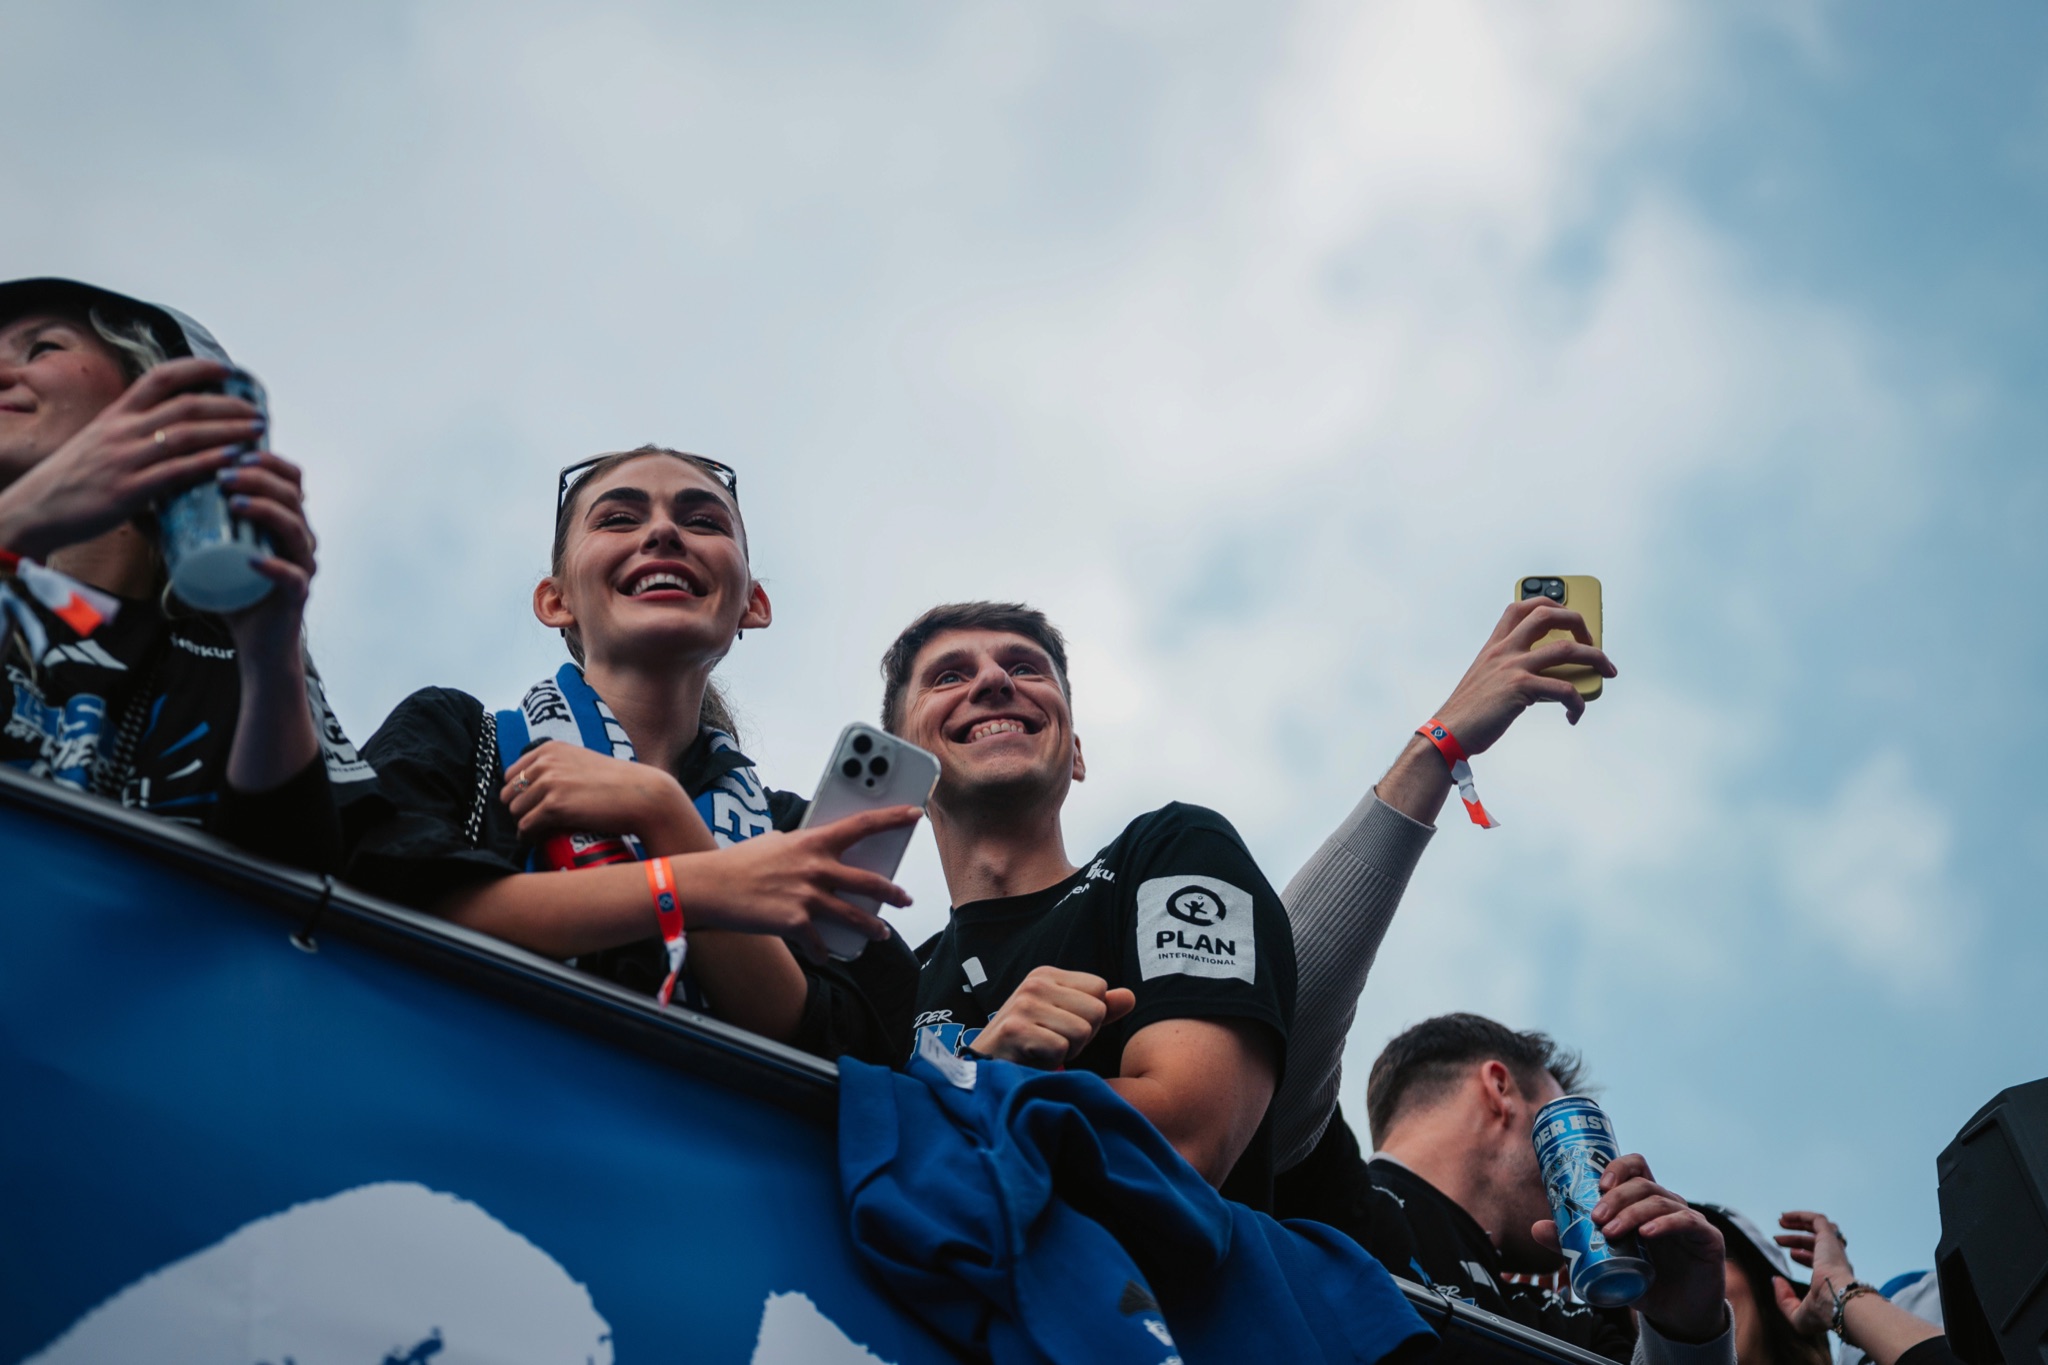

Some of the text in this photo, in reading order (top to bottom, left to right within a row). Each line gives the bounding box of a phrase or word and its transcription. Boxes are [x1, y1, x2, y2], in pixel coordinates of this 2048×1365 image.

[1156, 930, 1236, 956] PLAN
[1157, 951, 1237, 966] INTERNATIONAL
[912, 1008, 954, 1029] DER
[1533, 1114, 1614, 1156] DER HSV
